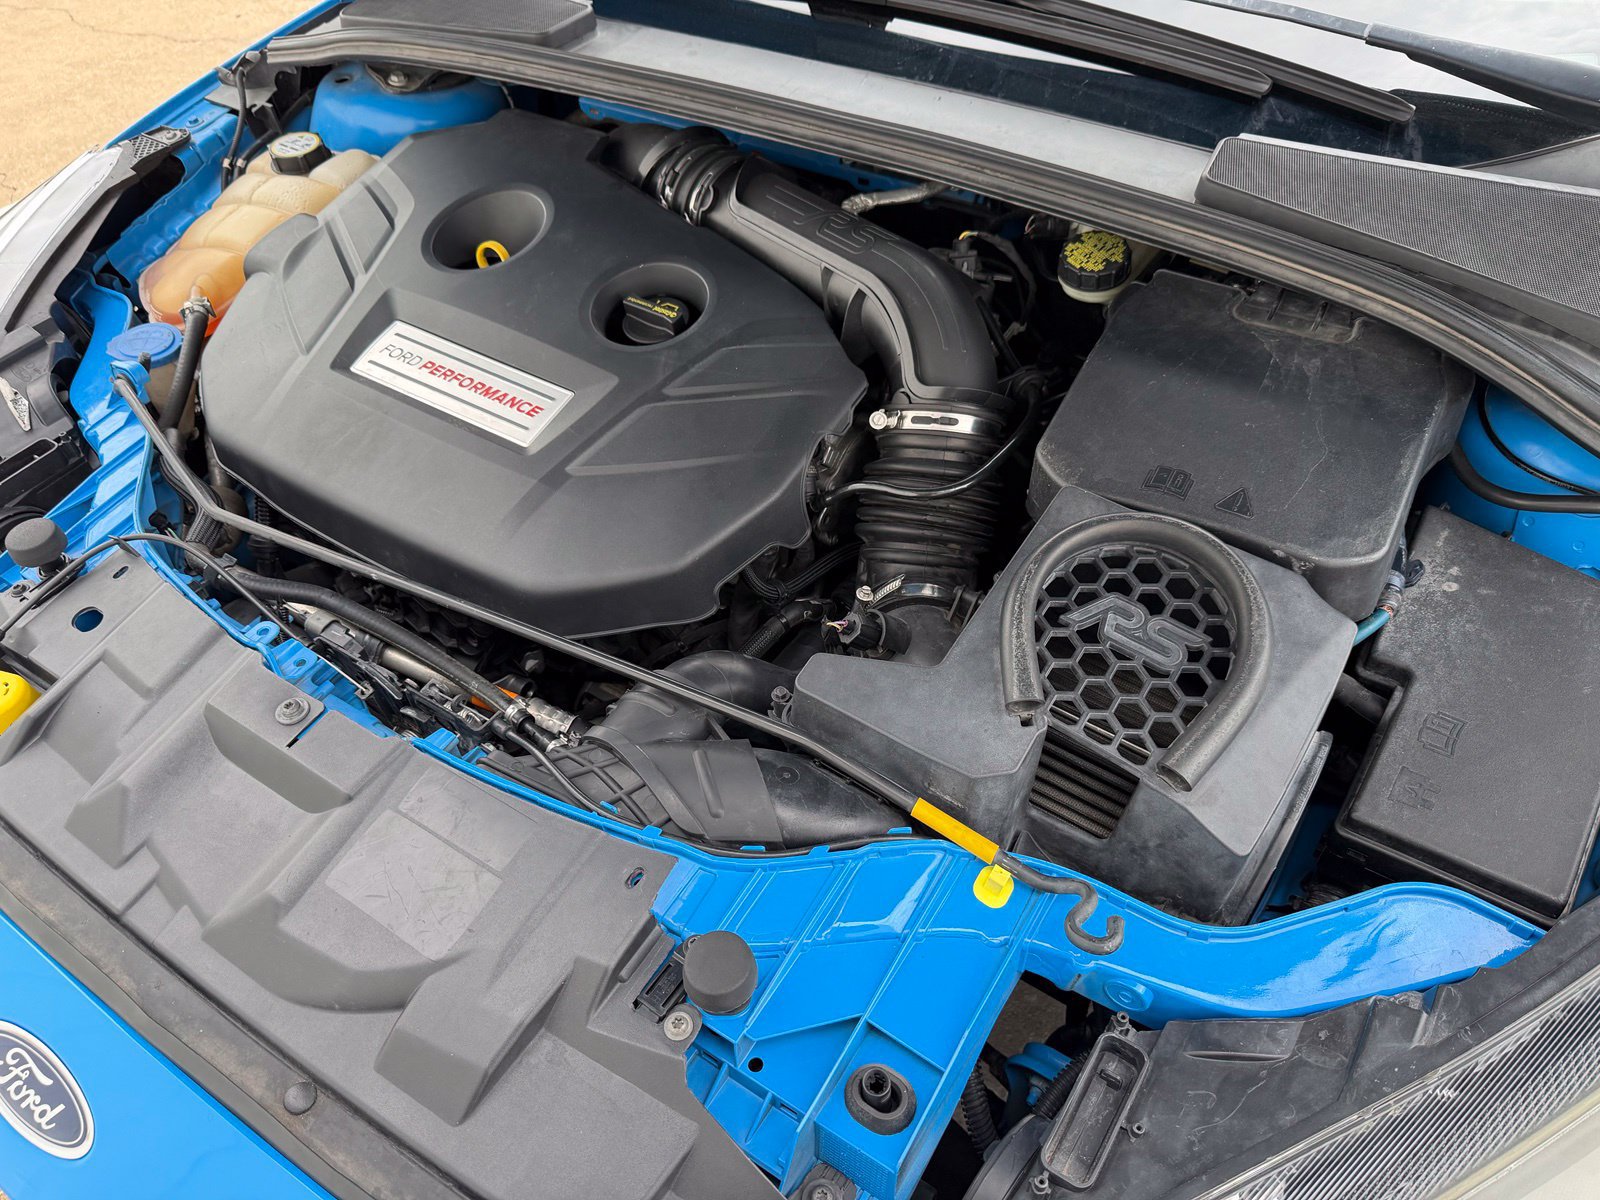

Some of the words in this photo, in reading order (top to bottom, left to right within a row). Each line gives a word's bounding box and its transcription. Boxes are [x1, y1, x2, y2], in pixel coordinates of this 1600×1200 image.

[793, 209, 899, 255] RS
[379, 344, 424, 366] FORD
[418, 360, 545, 419] PERFORMANCE
[1061, 593, 1211, 671] RS
[0, 1047, 66, 1130] Ford
